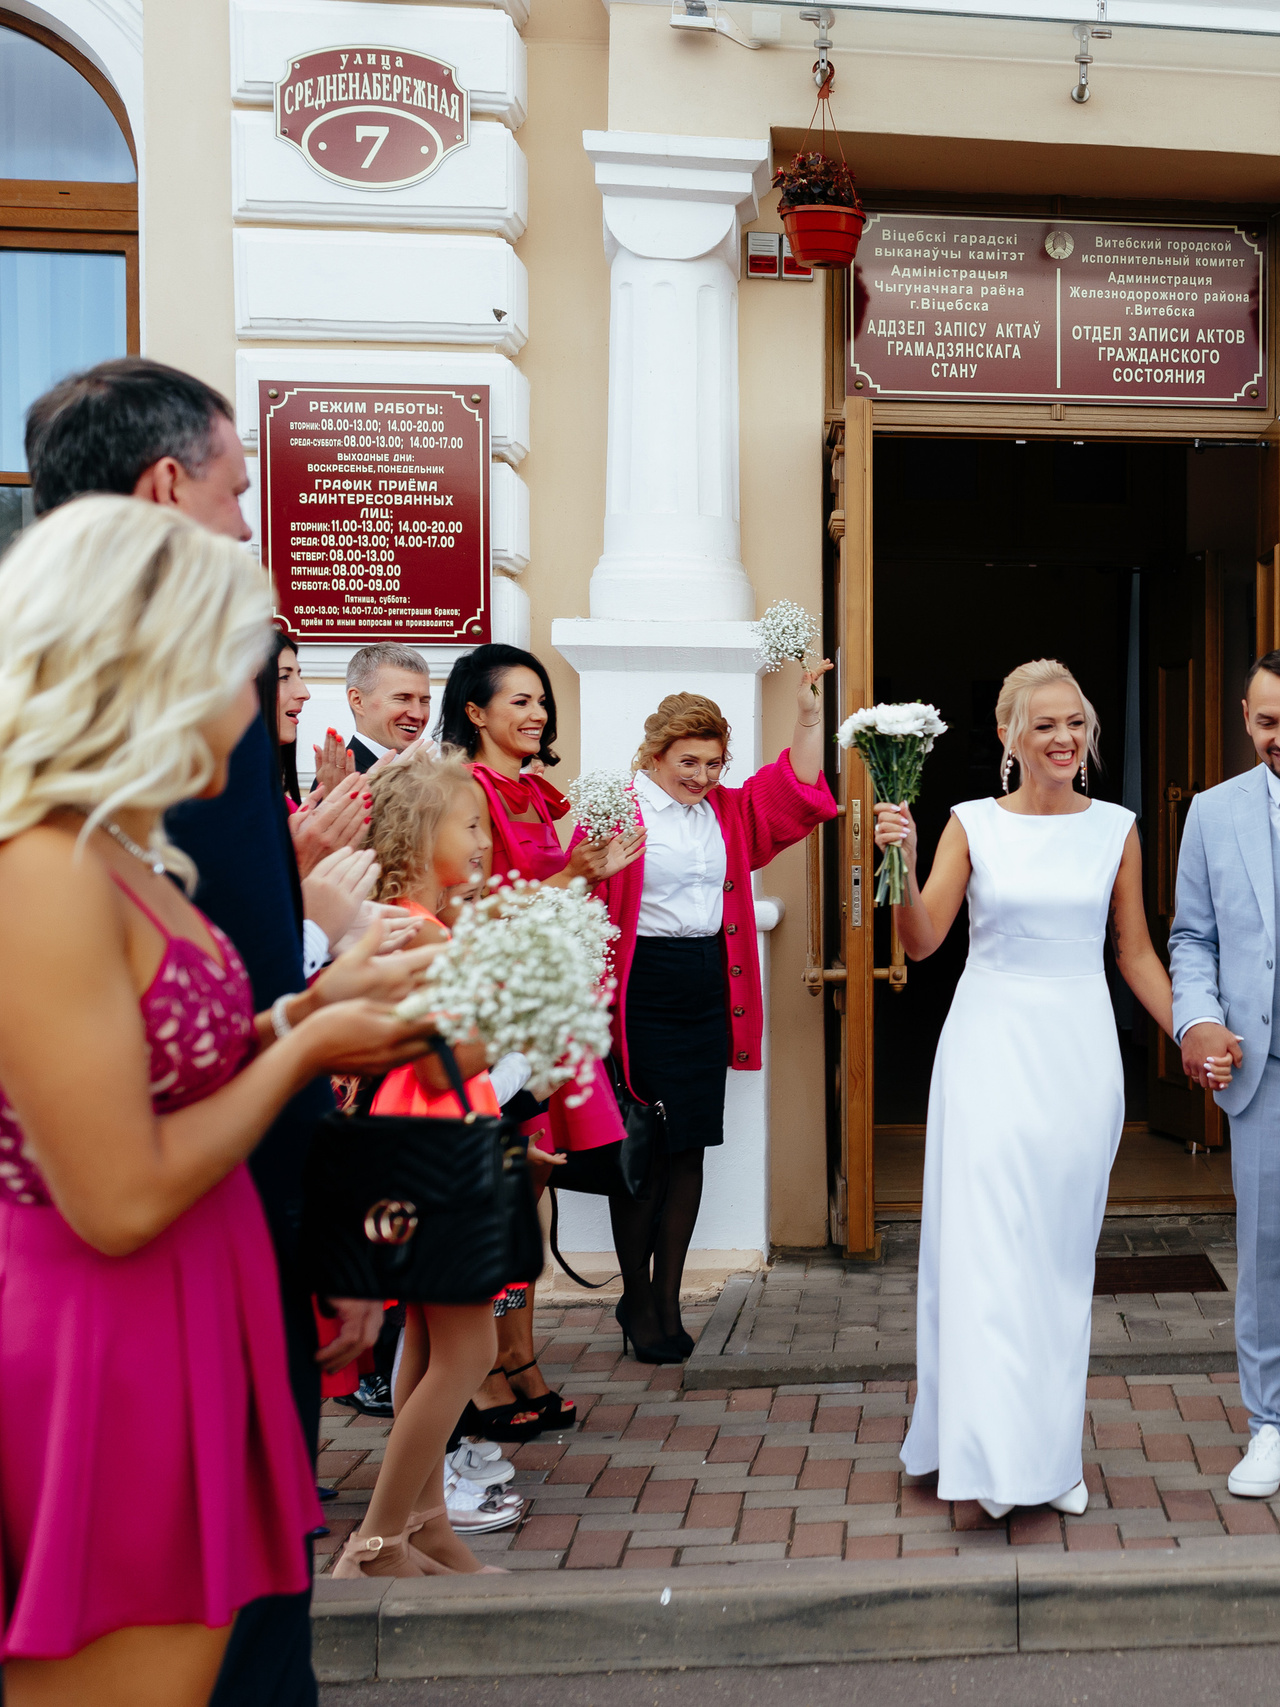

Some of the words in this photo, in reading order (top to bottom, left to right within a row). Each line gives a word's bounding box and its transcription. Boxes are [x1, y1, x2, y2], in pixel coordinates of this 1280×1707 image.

[340, 53, 404, 70] улица
[284, 72, 460, 123] СРЕДНЕНАБЕРЕЖНАЯ
[355, 125, 390, 169] 7
[882, 229, 946, 243] Віцебскі
[953, 233, 1018, 246] гарадскі
[1095, 236, 1162, 250] Витебский
[1167, 240, 1232, 252] городской
[874, 246, 961, 261] выканаўчы
[968, 249, 1025, 261] камітэт
[1081, 254, 1190, 266] исполнительный
[1195, 257, 1245, 268] комитет
[891, 265, 1008, 281] Адміністрацыя
[1108, 272, 1213, 287] Администрация
[874, 281, 973, 295] Чыгуначнага
[980, 283, 1025, 297] раёна
[1069, 286, 1198, 301] Железнодорожного
[1204, 291, 1250, 304] района
[867, 319, 926, 337] АДДЗЕЛ
[934, 321, 987, 337] ЗАПІСУ
[995, 320, 1041, 338] АКТАЎ
[1072, 325, 1122, 342] ОТДЕЛ
[1128, 327, 1190, 343] ЗАПИСИ
[1196, 329, 1245, 344] АКТОВ
[887, 341, 1021, 359] ГРАМАДЗЯНСКАГА
[1098, 347, 1220, 364] ГРАЖДАНСКОГО
[931, 362, 978, 379] СТАНУ
[1113, 368, 1205, 384] СОСТОЯНИЯ
[309, 401, 367, 414] РЕЖИМ
[374, 402, 443, 415] РАБОТЫ:
[387, 420, 444, 433] 14.00-20.00
[410, 436, 463, 449] 14.00-17.00
[337, 452, 390, 462] ВЫХОДНЫЕ
[393, 453, 415, 462] ДНИ:
[307, 463, 376, 474] ВОСКРЕСЕНЬЕ,
[377, 464, 445, 474] ПОНЕДЕЛЬНИК
[314, 479, 372, 491] ГРАФИК
[378, 478, 438, 492] ПРИЁМА
[298, 492, 454, 506] ЗАИНТЕРЕСОВАННЫХ
[359, 507, 393, 519] ЛИЦ:
[331, 519, 394, 534] 11.00-13.00;
[398, 520, 463, 534] 14.00-20.00
[290, 537, 320, 546] СРЕДА:
[320, 534, 389, 549] 08.00-13.00;
[393, 535, 455, 548] 14.00-17.00
[290, 551, 328, 561] ЧЕТВЕРГ:
[329, 549, 395, 562] 08.00-13.00
[290, 566, 332, 576] ПЯТНИЦА:
[332, 564, 401, 577] 08.00-09.00
[291, 581, 330, 591] СУББОТА:
[331, 578, 400, 591] 08.00-09.00
